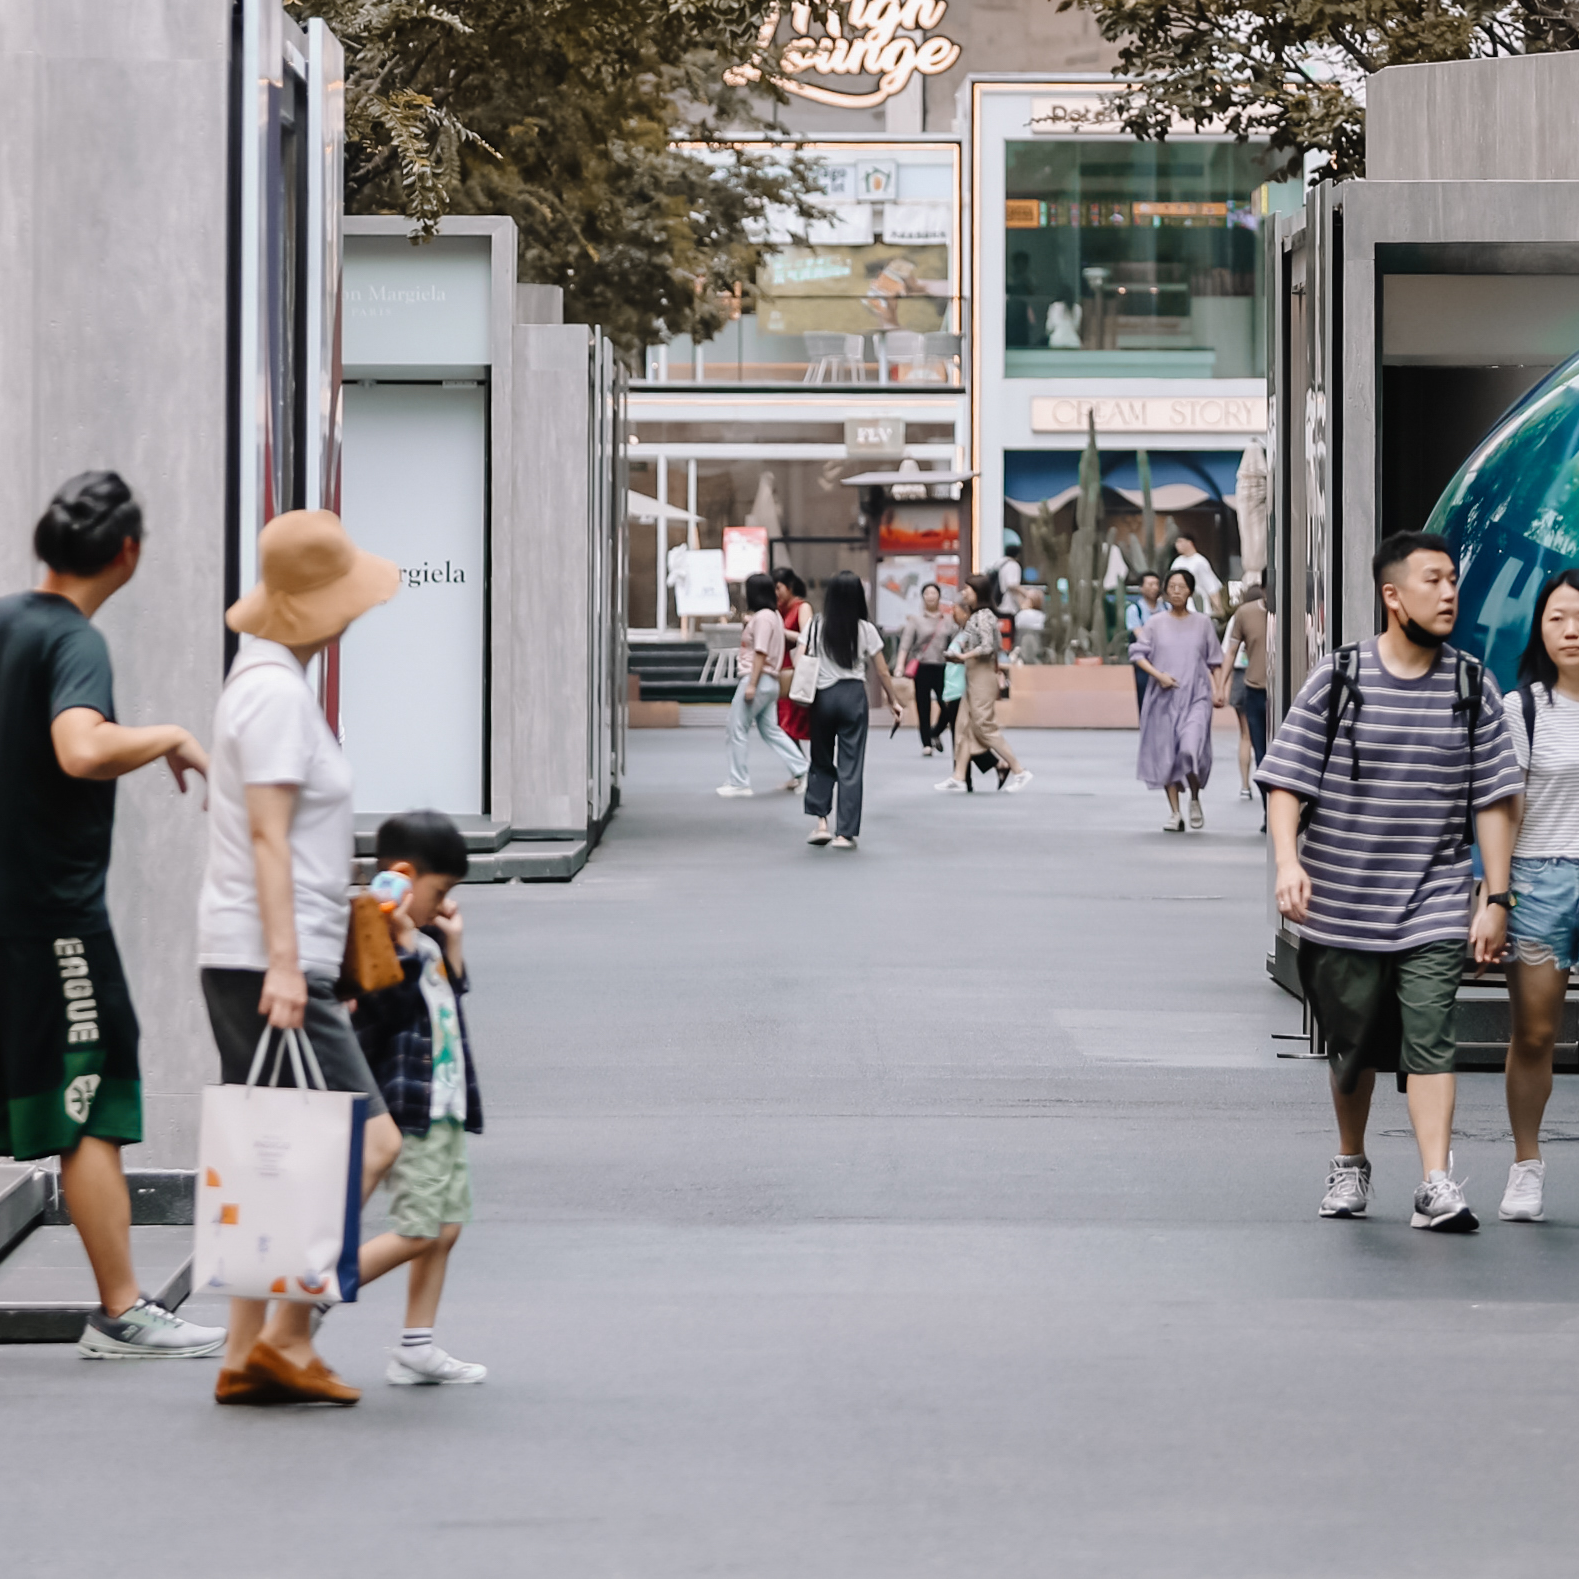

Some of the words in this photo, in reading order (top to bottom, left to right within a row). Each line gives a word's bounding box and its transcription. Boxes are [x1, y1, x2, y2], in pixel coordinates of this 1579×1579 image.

[368, 284, 446, 304] Margiela
[1169, 399, 1256, 426] STORY
[398, 559, 466, 588] rgiela
